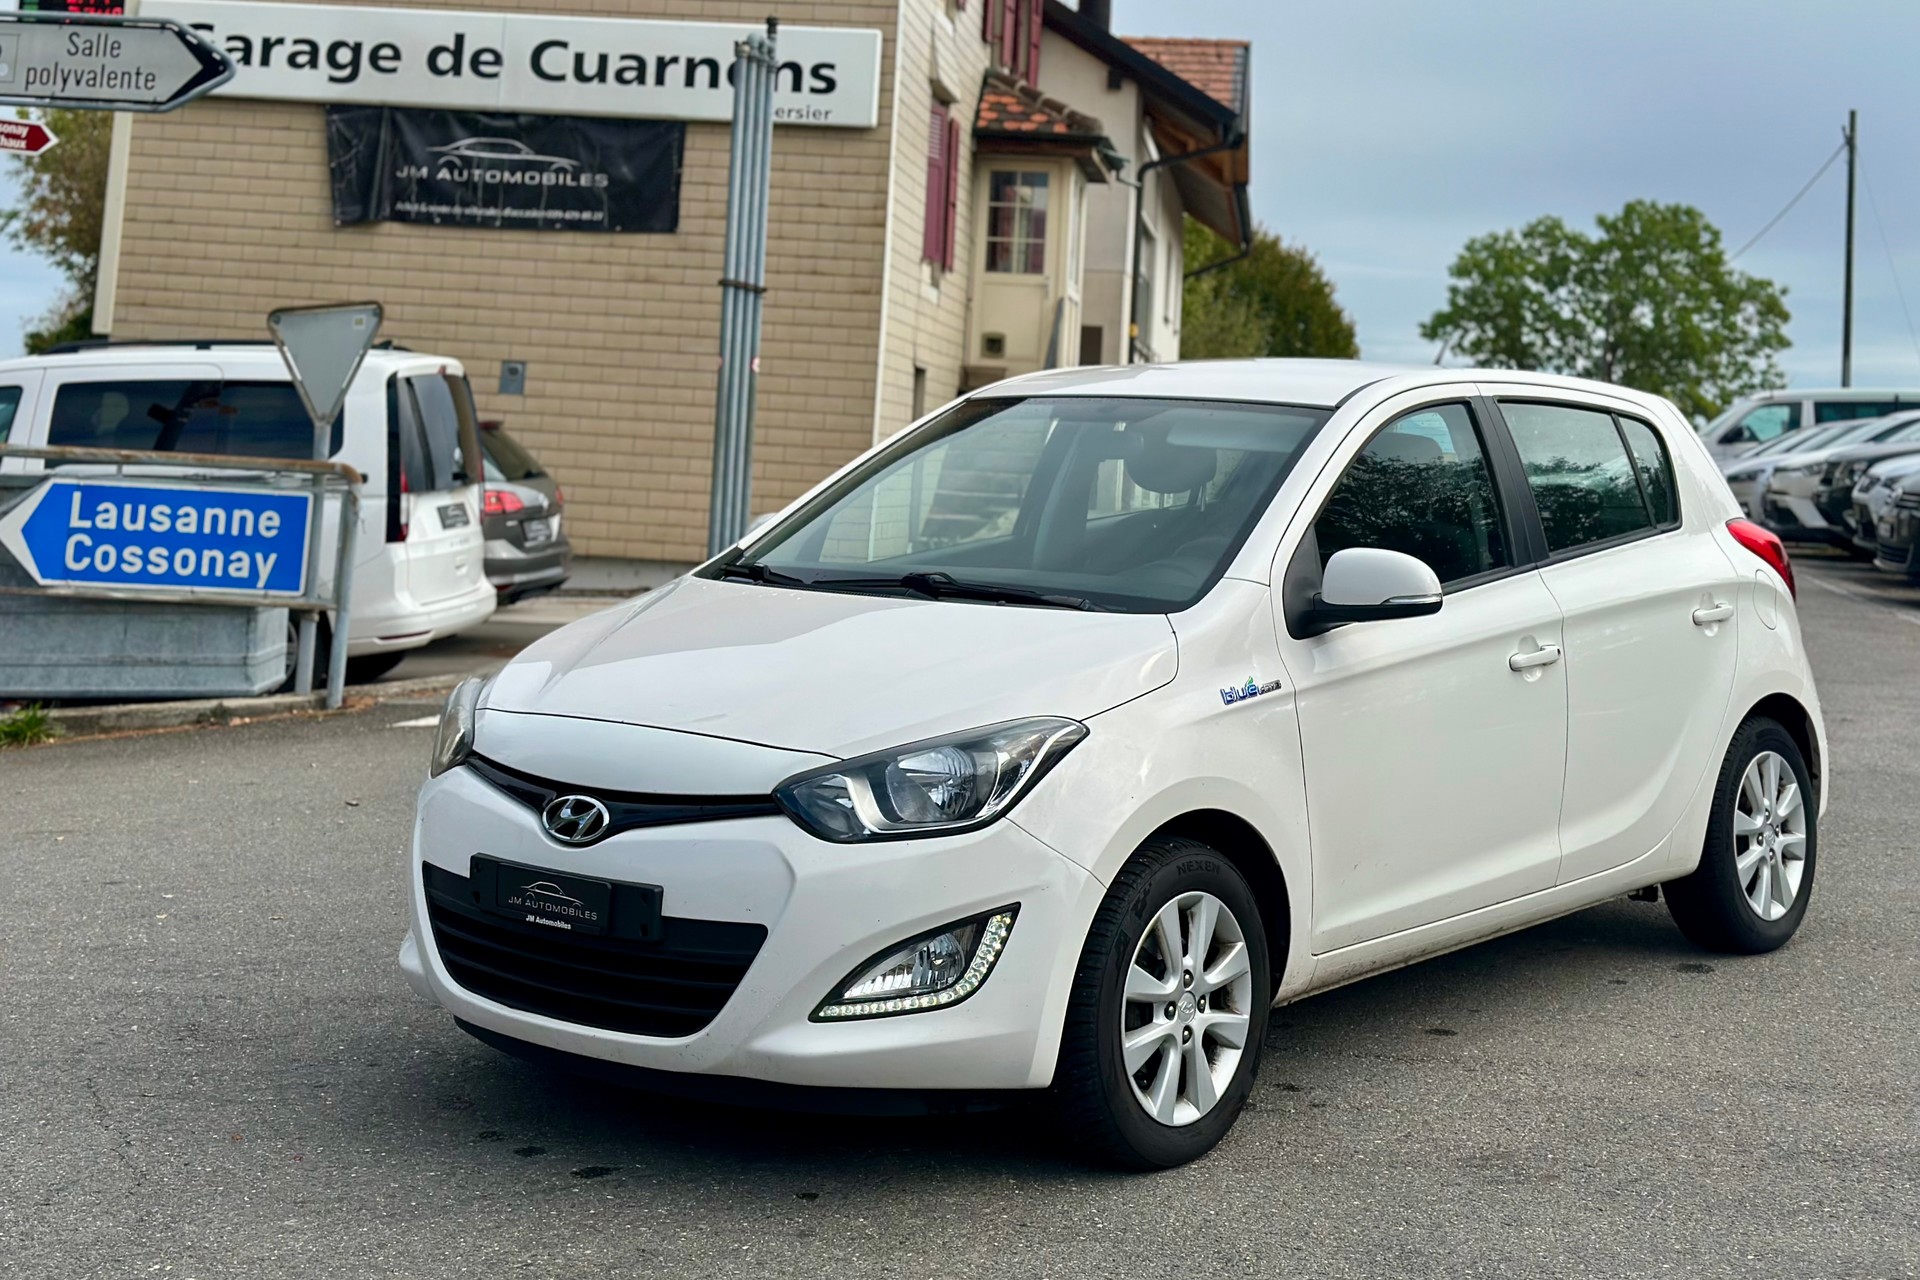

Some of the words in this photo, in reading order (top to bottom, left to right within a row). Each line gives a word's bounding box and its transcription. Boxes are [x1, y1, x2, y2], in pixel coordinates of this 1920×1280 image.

[66, 31, 122, 58] Salle
[427, 33, 504, 79] de
[529, 39, 838, 94] Cuarnns
[25, 62, 156, 92] polyvalente
[774, 104, 833, 120] ersier
[395, 165, 429, 181] JM
[436, 166, 609, 188] AUTOMOBILES
[69, 491, 281, 538] Lausanne
[64, 533, 278, 589] Cossonay
[1175, 860, 1222, 876] NEXEN
[508, 896, 522, 905] JM
[525, 899, 597, 920] AUTOMOBILES
[526, 914, 535, 922] JM
[535, 916, 572, 930] Automobiles
